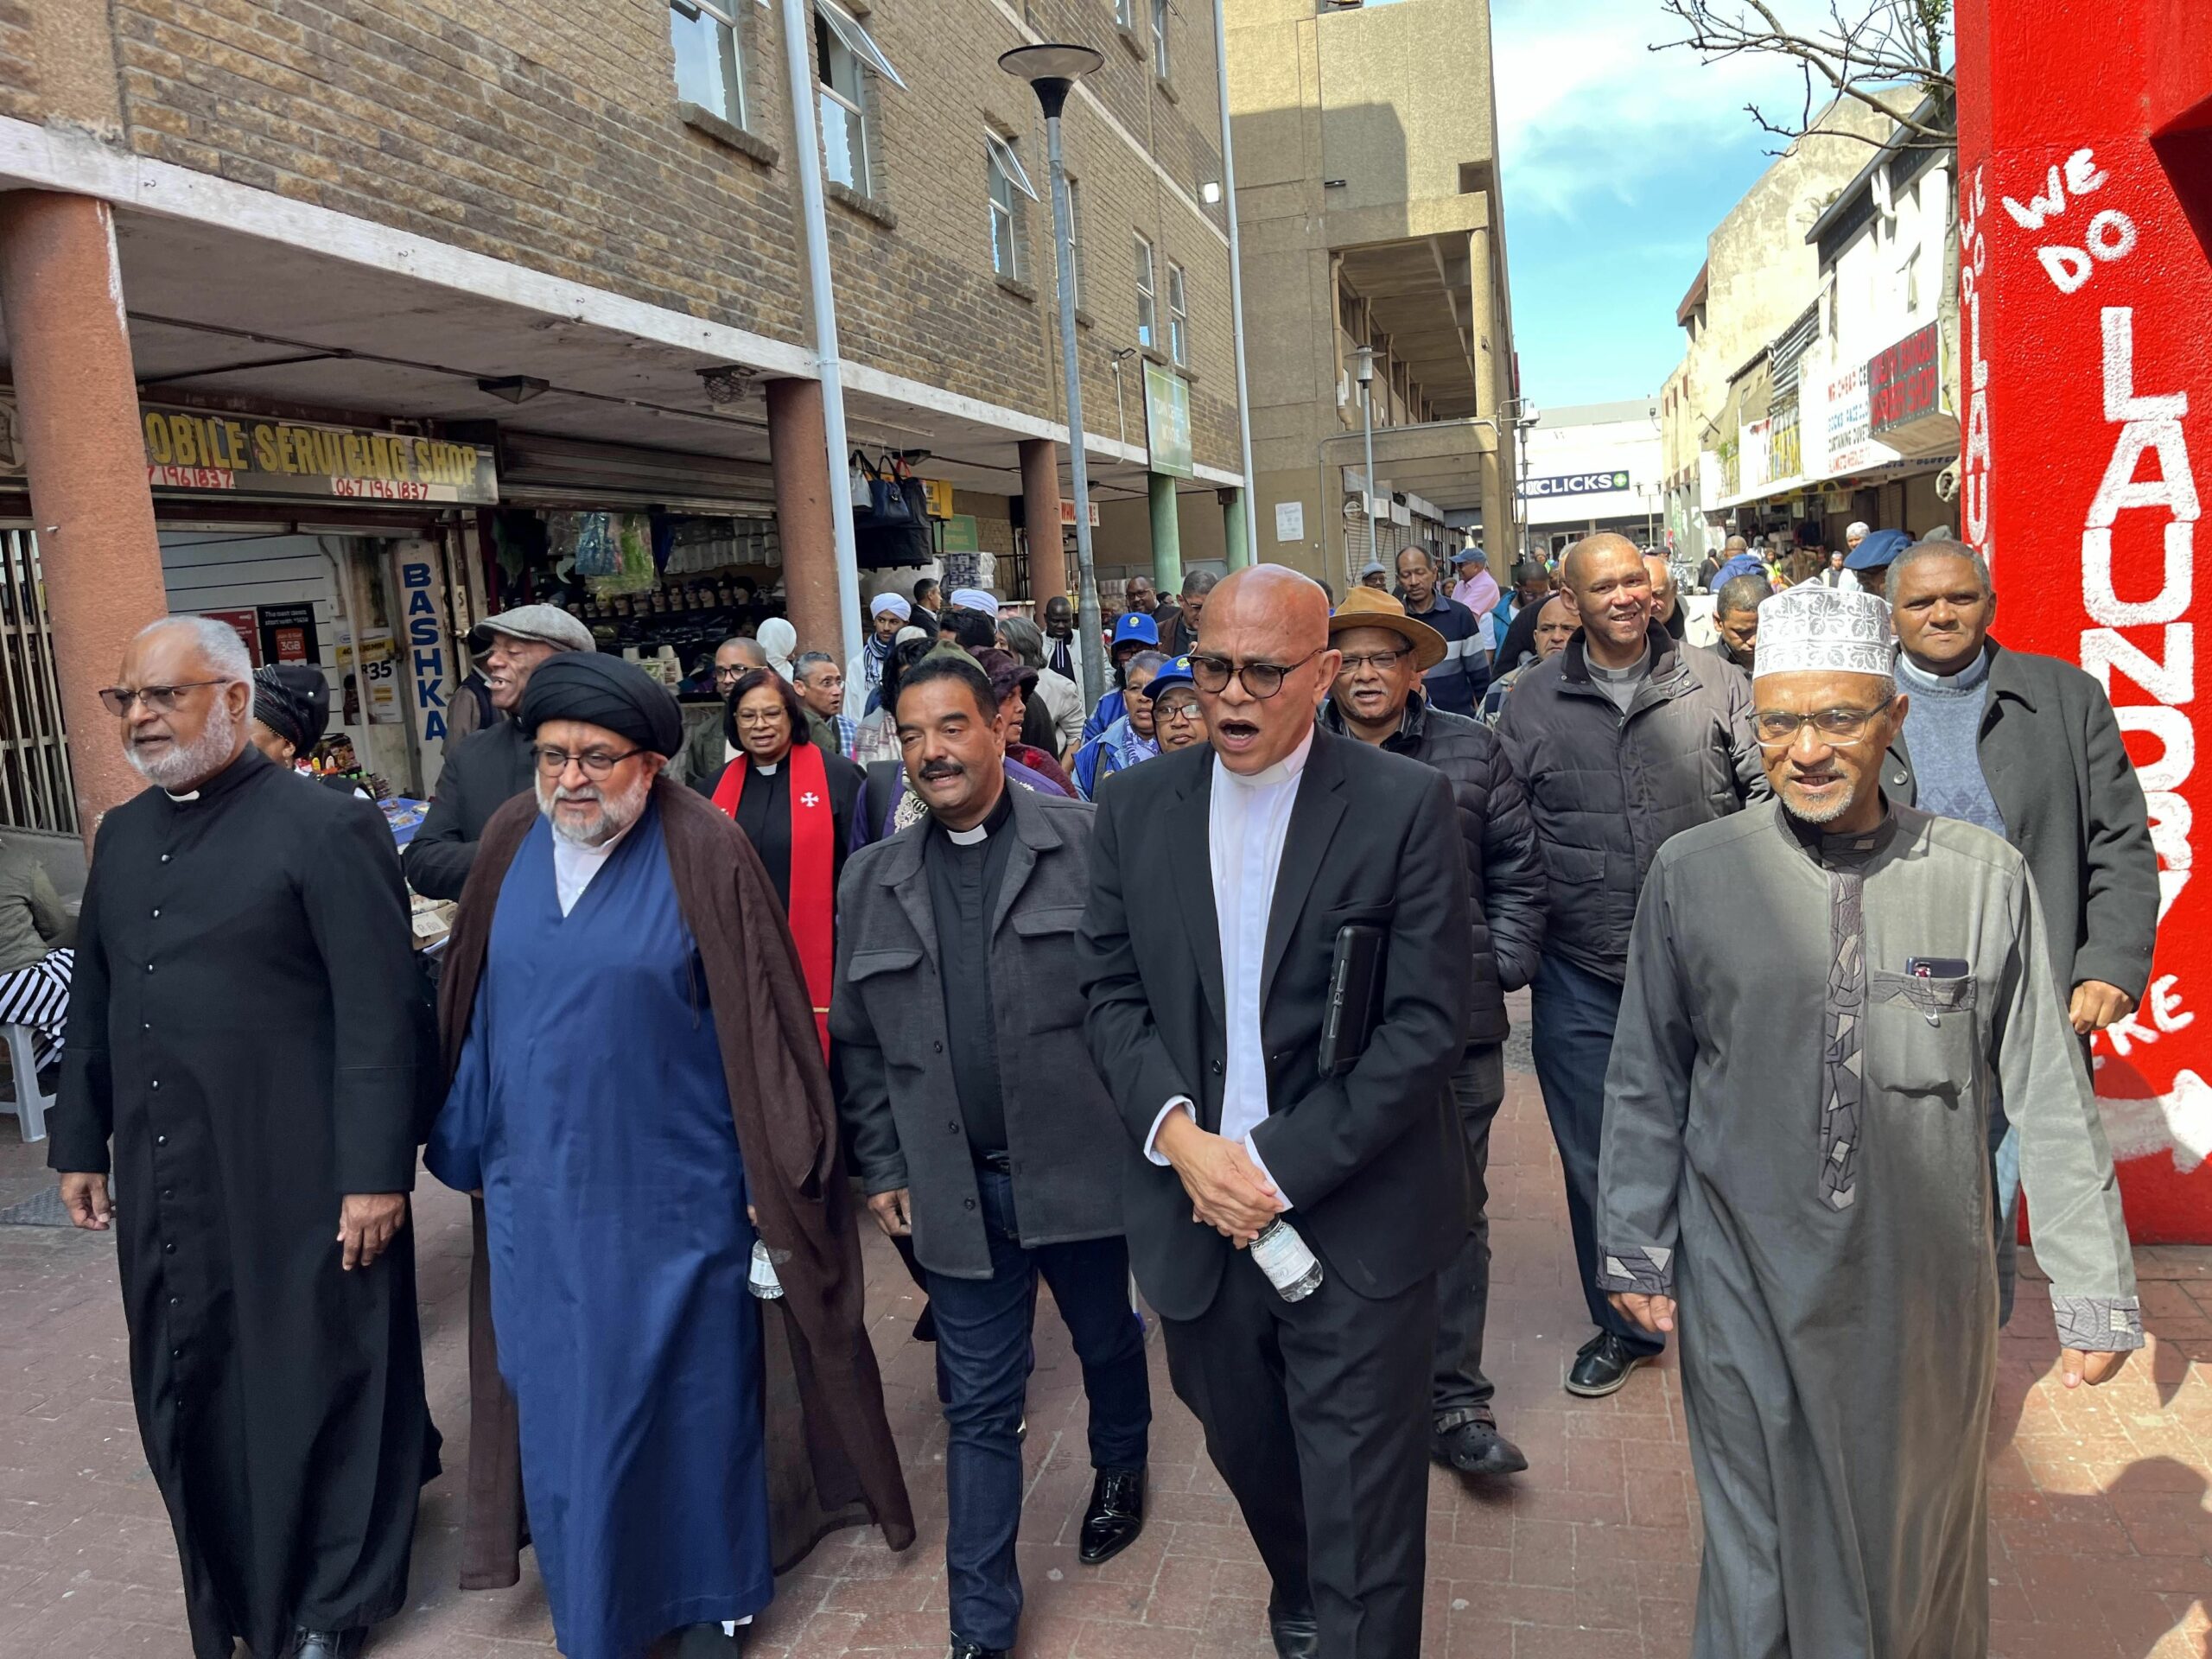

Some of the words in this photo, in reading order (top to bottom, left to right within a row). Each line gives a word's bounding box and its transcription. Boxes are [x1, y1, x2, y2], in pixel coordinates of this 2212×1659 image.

[2000, 148, 2111, 231] WE
[2037, 209, 2139, 295] DO
[1907, 366, 1936, 413] SHOP
[145, 412, 249, 470] OBILE
[414, 440, 476, 485] SHOP
[1967, 291, 1991, 563] LAU
[1536, 474, 1612, 494] CLICKS
[280, 640, 301, 651] 3GB
[360, 659, 392, 680] R35
[403, 563, 448, 741] BASHKA
